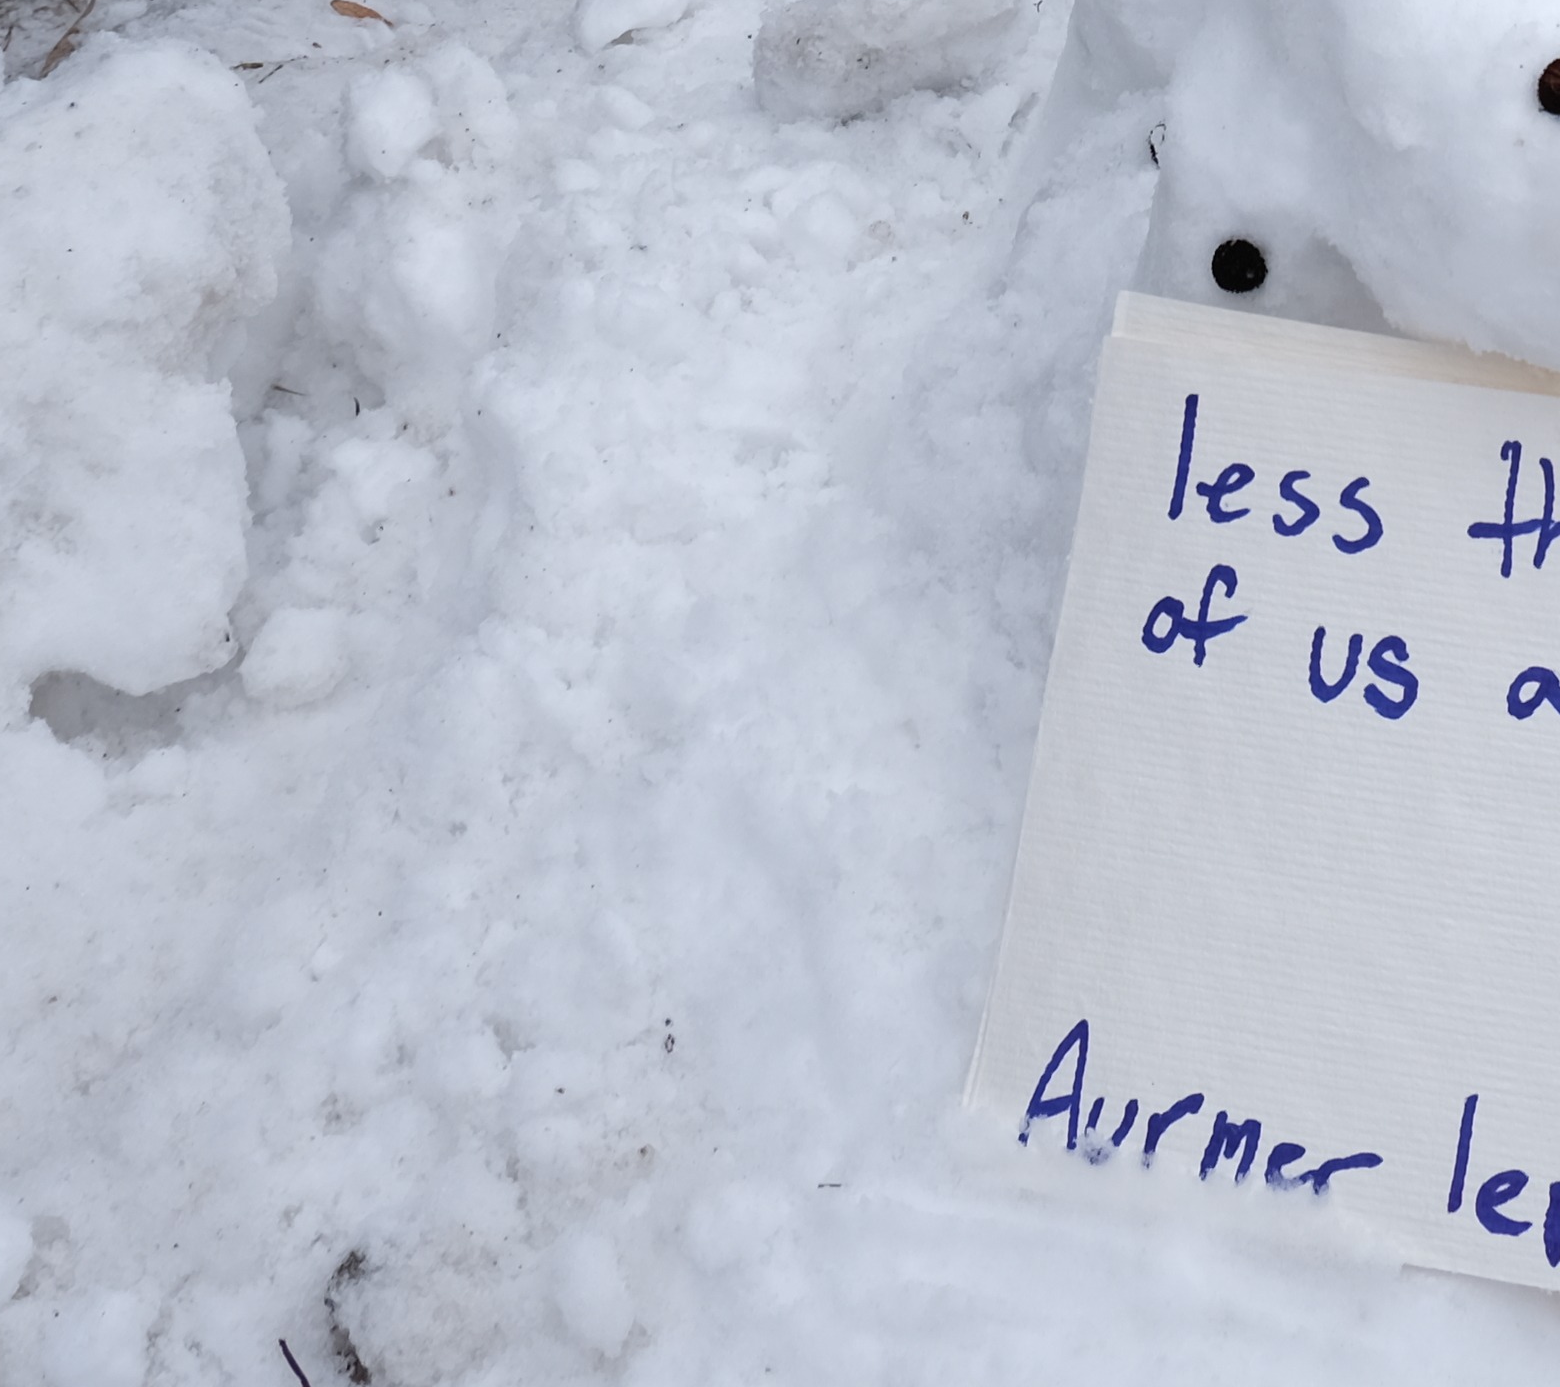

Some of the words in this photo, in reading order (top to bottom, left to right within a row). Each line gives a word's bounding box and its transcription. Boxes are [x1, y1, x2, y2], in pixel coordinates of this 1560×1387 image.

[1170, 395, 1383, 555] less
[1143, 565, 1248, 666] of
[1310, 628, 1419, 720] us
